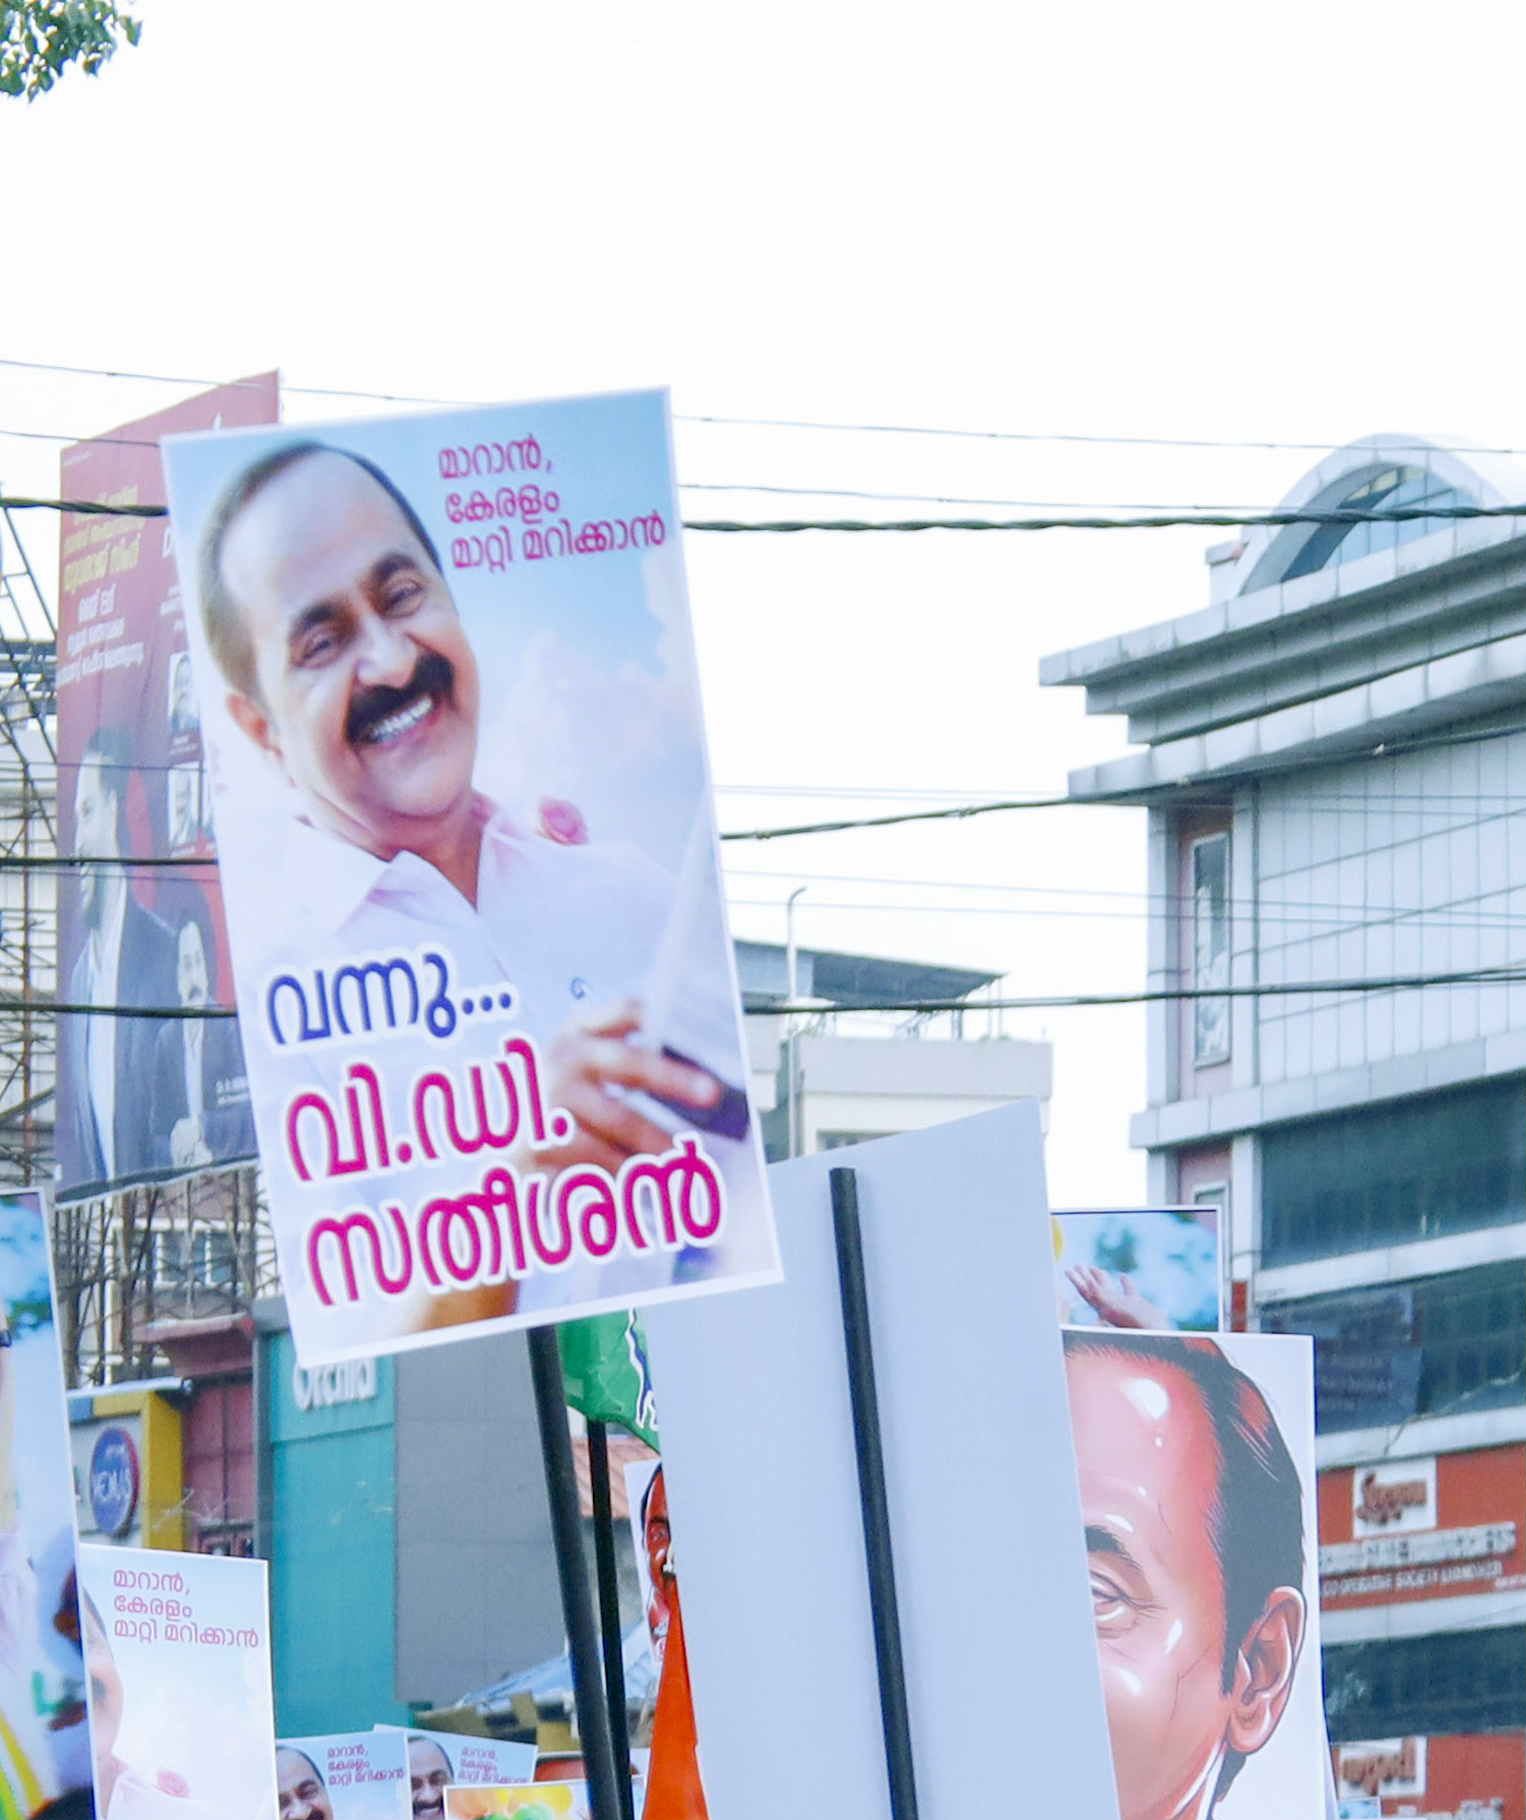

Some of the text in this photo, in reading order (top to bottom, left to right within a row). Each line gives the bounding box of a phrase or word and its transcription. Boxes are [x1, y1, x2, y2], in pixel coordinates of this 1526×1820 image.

[439, 434, 553, 481] മാറാൻ,
[444, 490, 561, 525] കേരളം
[451, 511, 666, 575] മാറ്റി മറിക്കാൻ
[266, 951, 513, 1047] വന്നു...
[285, 1039, 570, 1181] വി.ഡി.
[307, 1139, 722, 1305] സതീശൻ
[114, 1568, 190, 1595] മാറാൻ,
[114, 1595, 192, 1621] കേരളം
[114, 1620, 259, 1649] മാറ്റി മറിക്കാൻ
